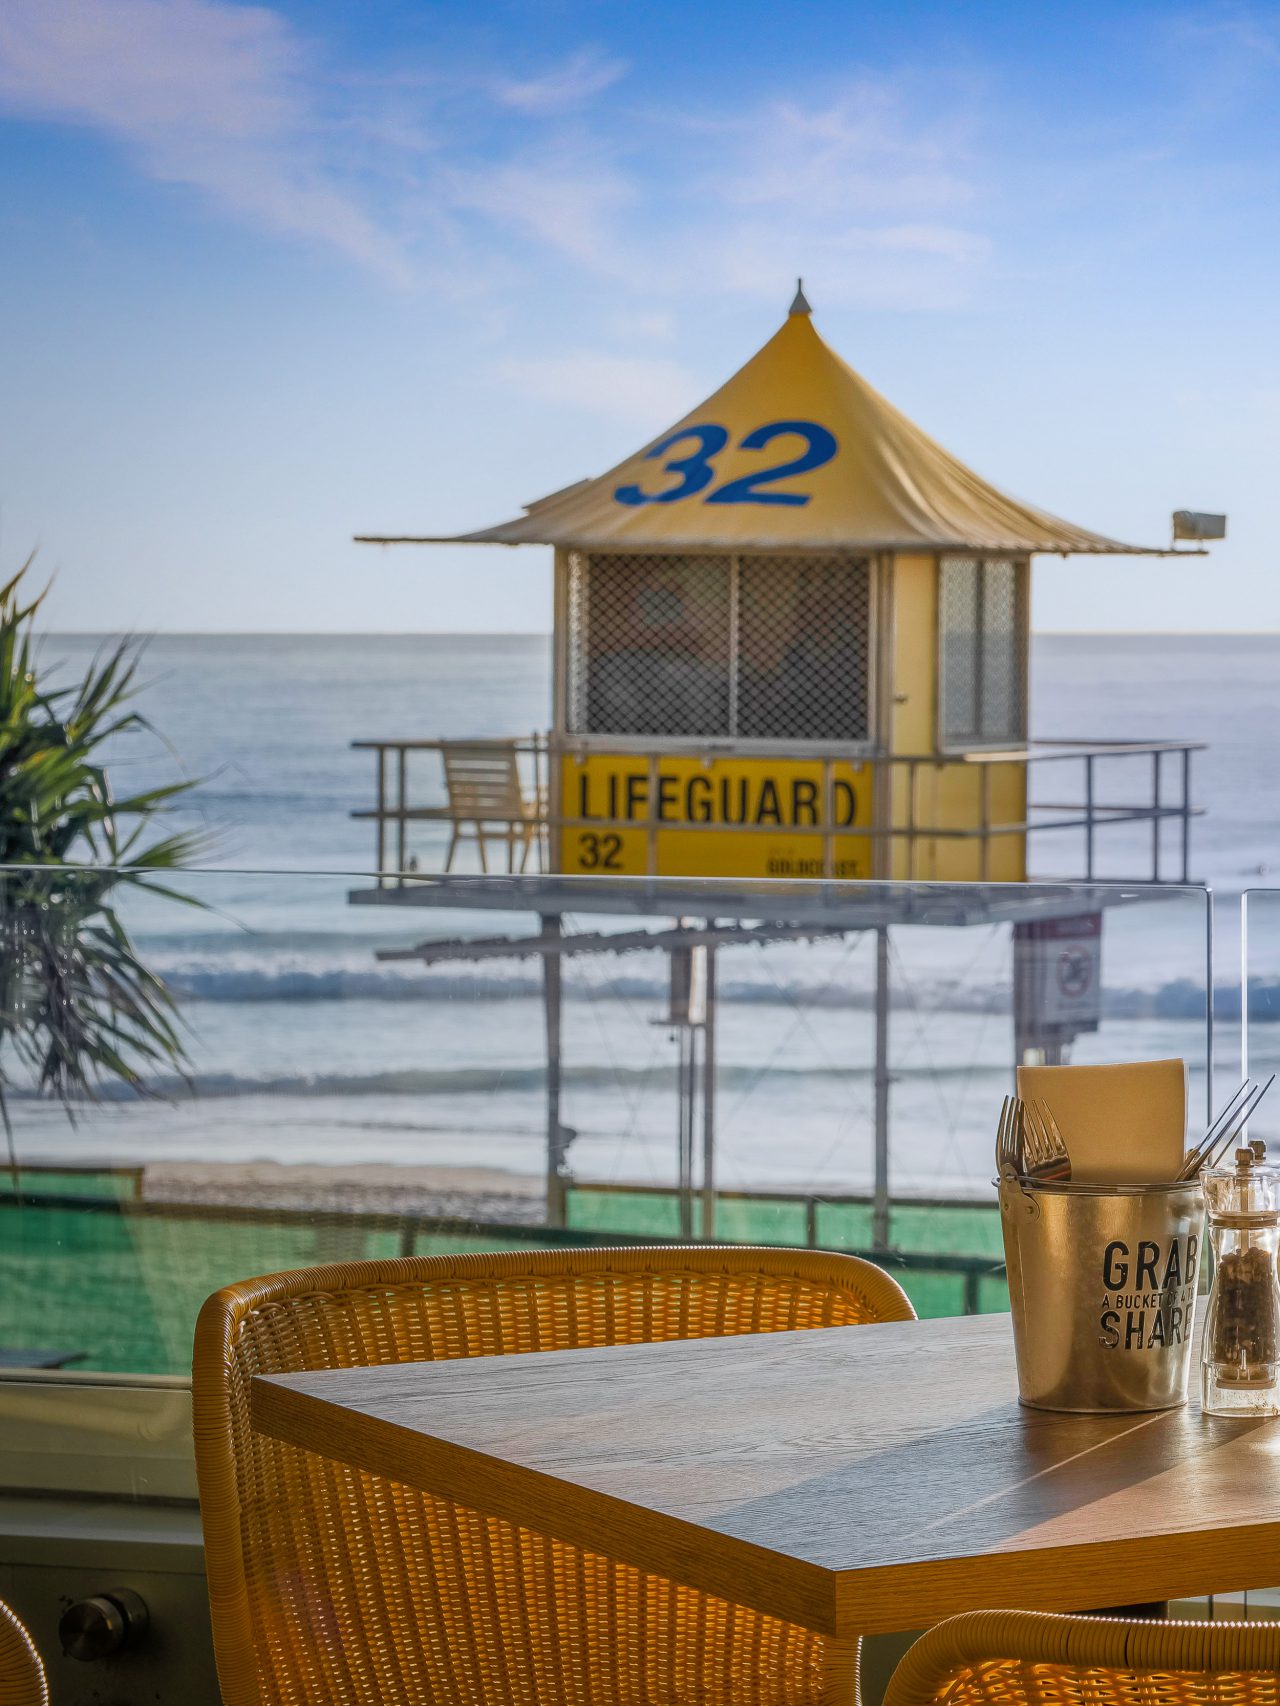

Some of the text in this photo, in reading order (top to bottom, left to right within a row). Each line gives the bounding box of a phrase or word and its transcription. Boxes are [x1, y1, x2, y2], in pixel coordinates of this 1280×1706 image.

[612, 420, 839, 507] 32
[578, 773, 858, 828] LIFEGUARD
[578, 833, 625, 871] 32
[1103, 1235, 1198, 1291] GRAB
[1102, 1293, 1110, 1309] A
[1115, 1291, 1164, 1310] BUCKET
[1099, 1303, 1193, 1350] SHARE
